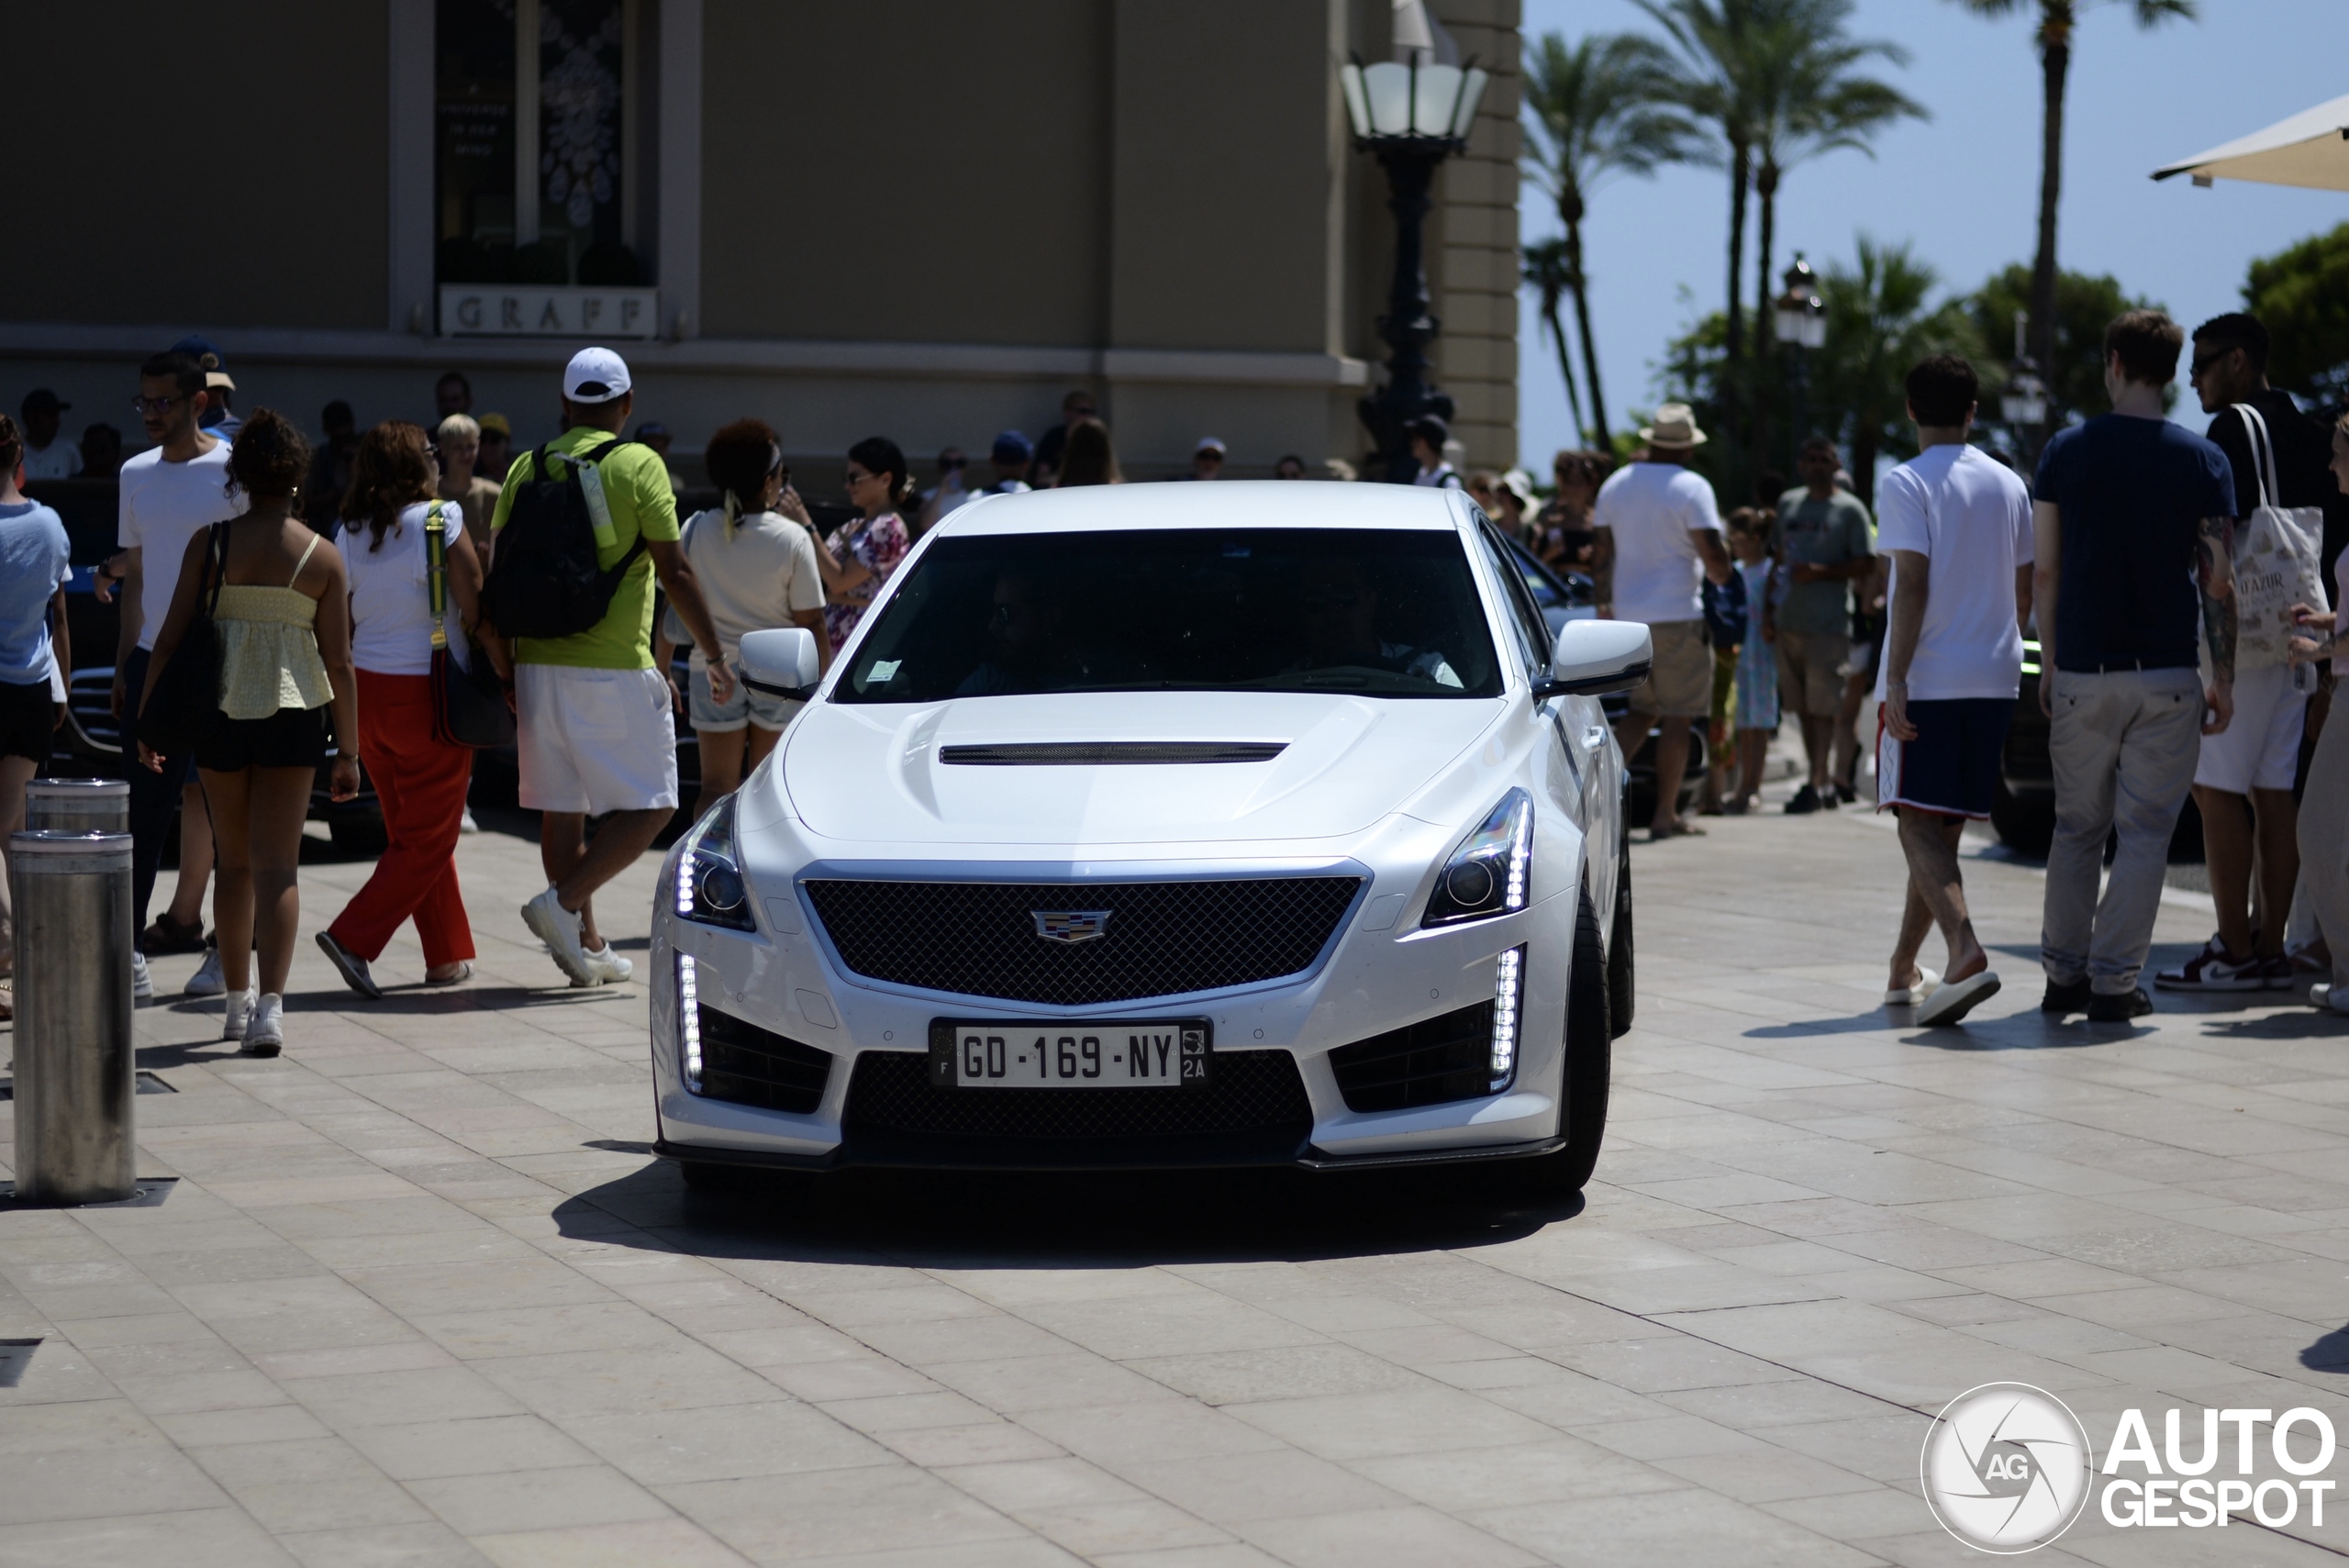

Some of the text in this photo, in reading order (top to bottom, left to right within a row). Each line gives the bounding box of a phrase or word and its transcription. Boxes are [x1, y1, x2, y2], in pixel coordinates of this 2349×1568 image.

[457, 296, 641, 331] GRAFF
[941, 1062, 948, 1073] F
[1183, 1060, 1206, 1078] 2A
